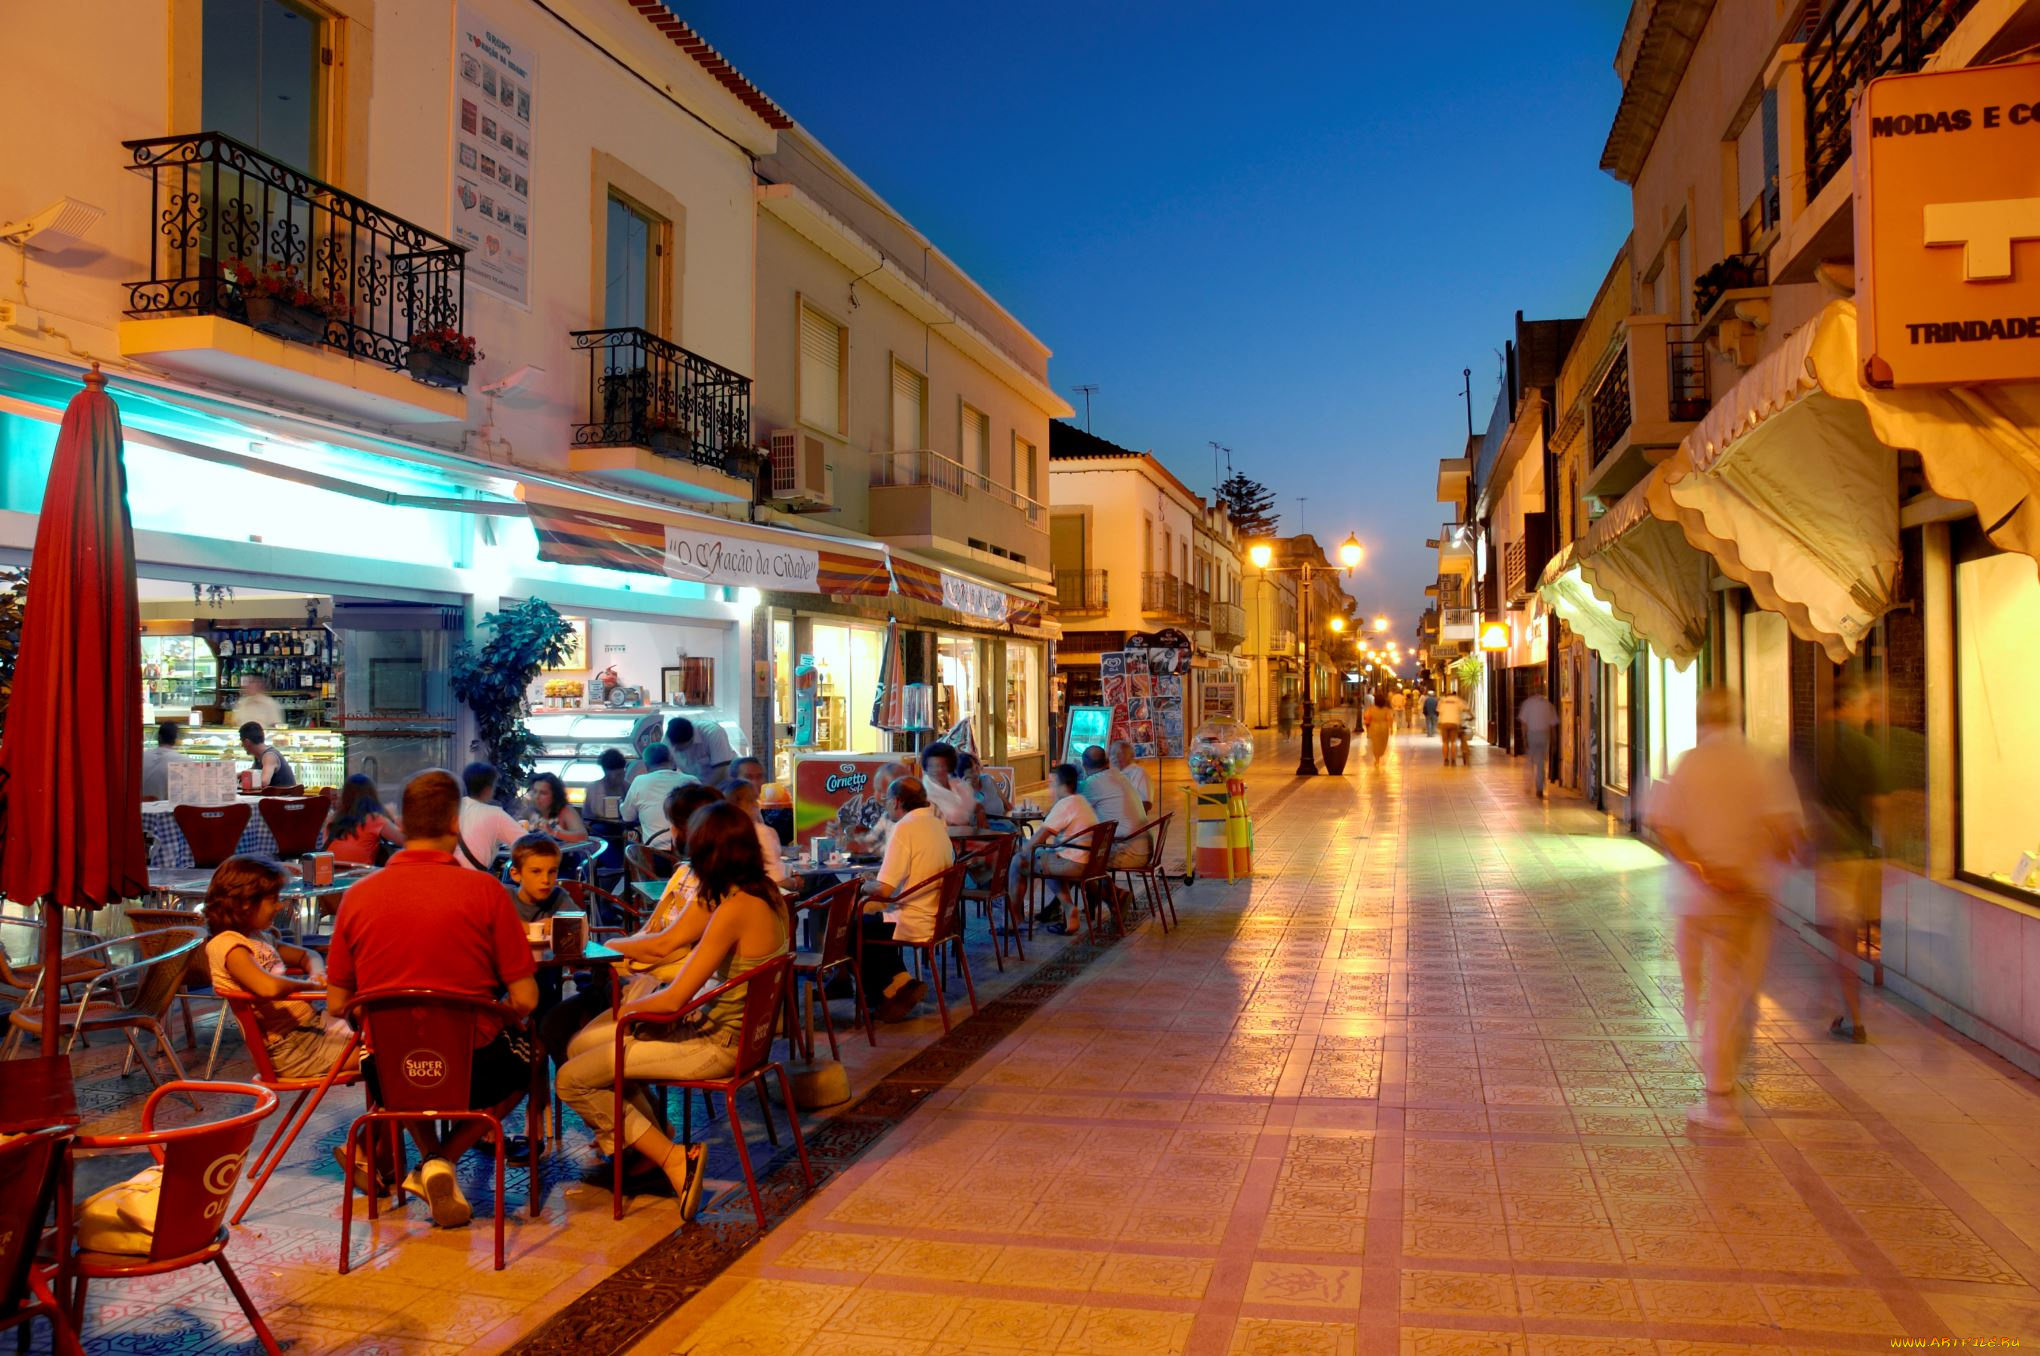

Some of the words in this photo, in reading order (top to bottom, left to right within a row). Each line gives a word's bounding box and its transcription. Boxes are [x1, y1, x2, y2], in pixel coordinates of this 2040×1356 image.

[485, 31, 512, 55] GRUPO
[1872, 109, 1972, 138] MODAS
[1983, 106, 2001, 129] E
[1905, 316, 2040, 345] TRINDADE
[756, 549, 771, 575] da
[826, 773, 867, 792] Cornetto
[849, 783, 864, 793] Soft
[408, 1068, 442, 1077] BOCK
